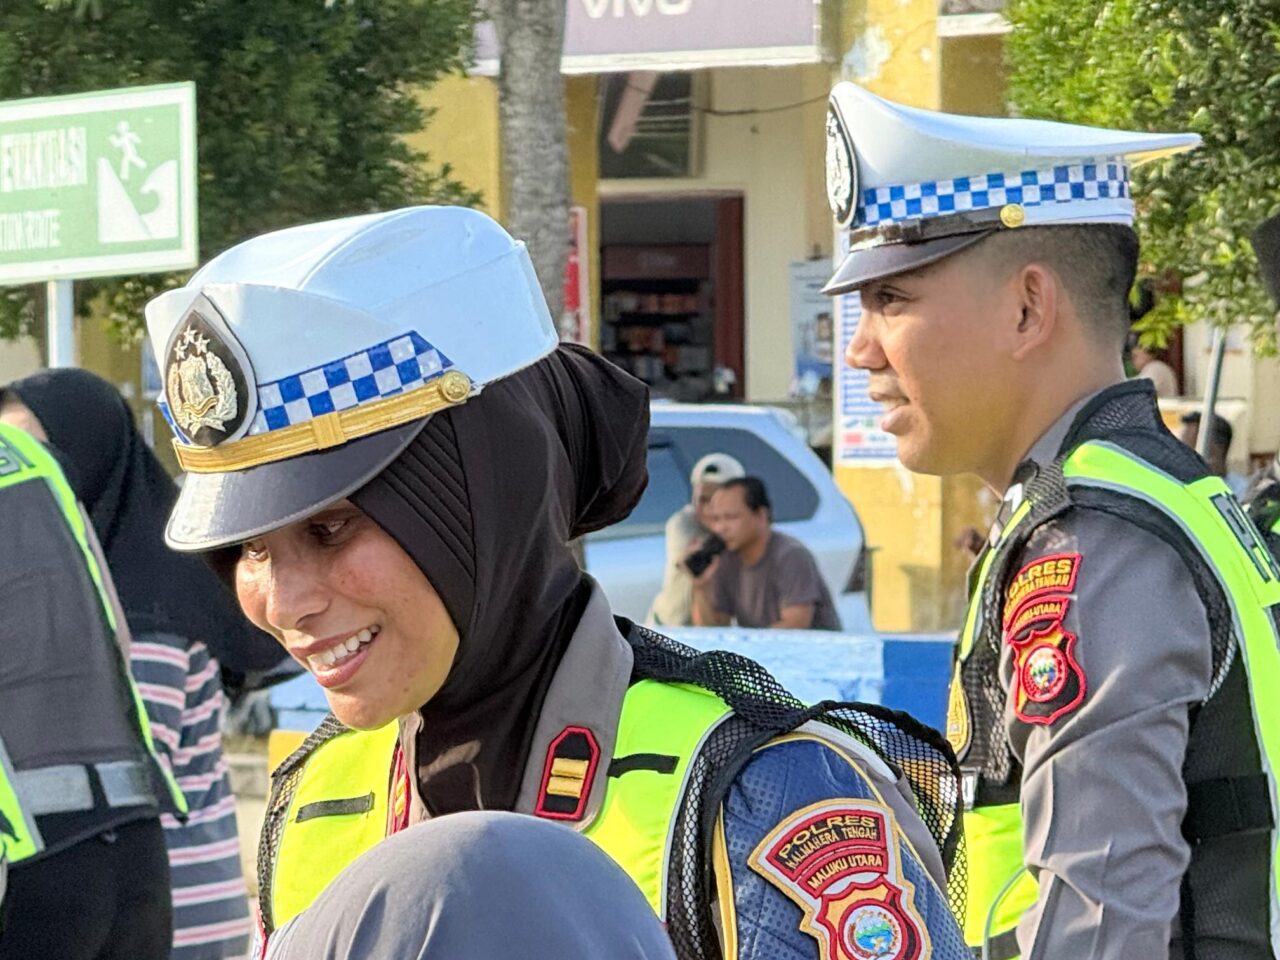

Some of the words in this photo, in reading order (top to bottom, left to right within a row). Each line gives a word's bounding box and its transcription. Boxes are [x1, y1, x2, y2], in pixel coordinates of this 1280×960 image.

[1008, 559, 1072, 599] OLRES
[778, 815, 876, 859] POLRES
[785, 828, 839, 870] HALMAHERA
[841, 825, 878, 840] TENGAH
[807, 860, 849, 890] MALUKU
[849, 855, 882, 867] UTARA
